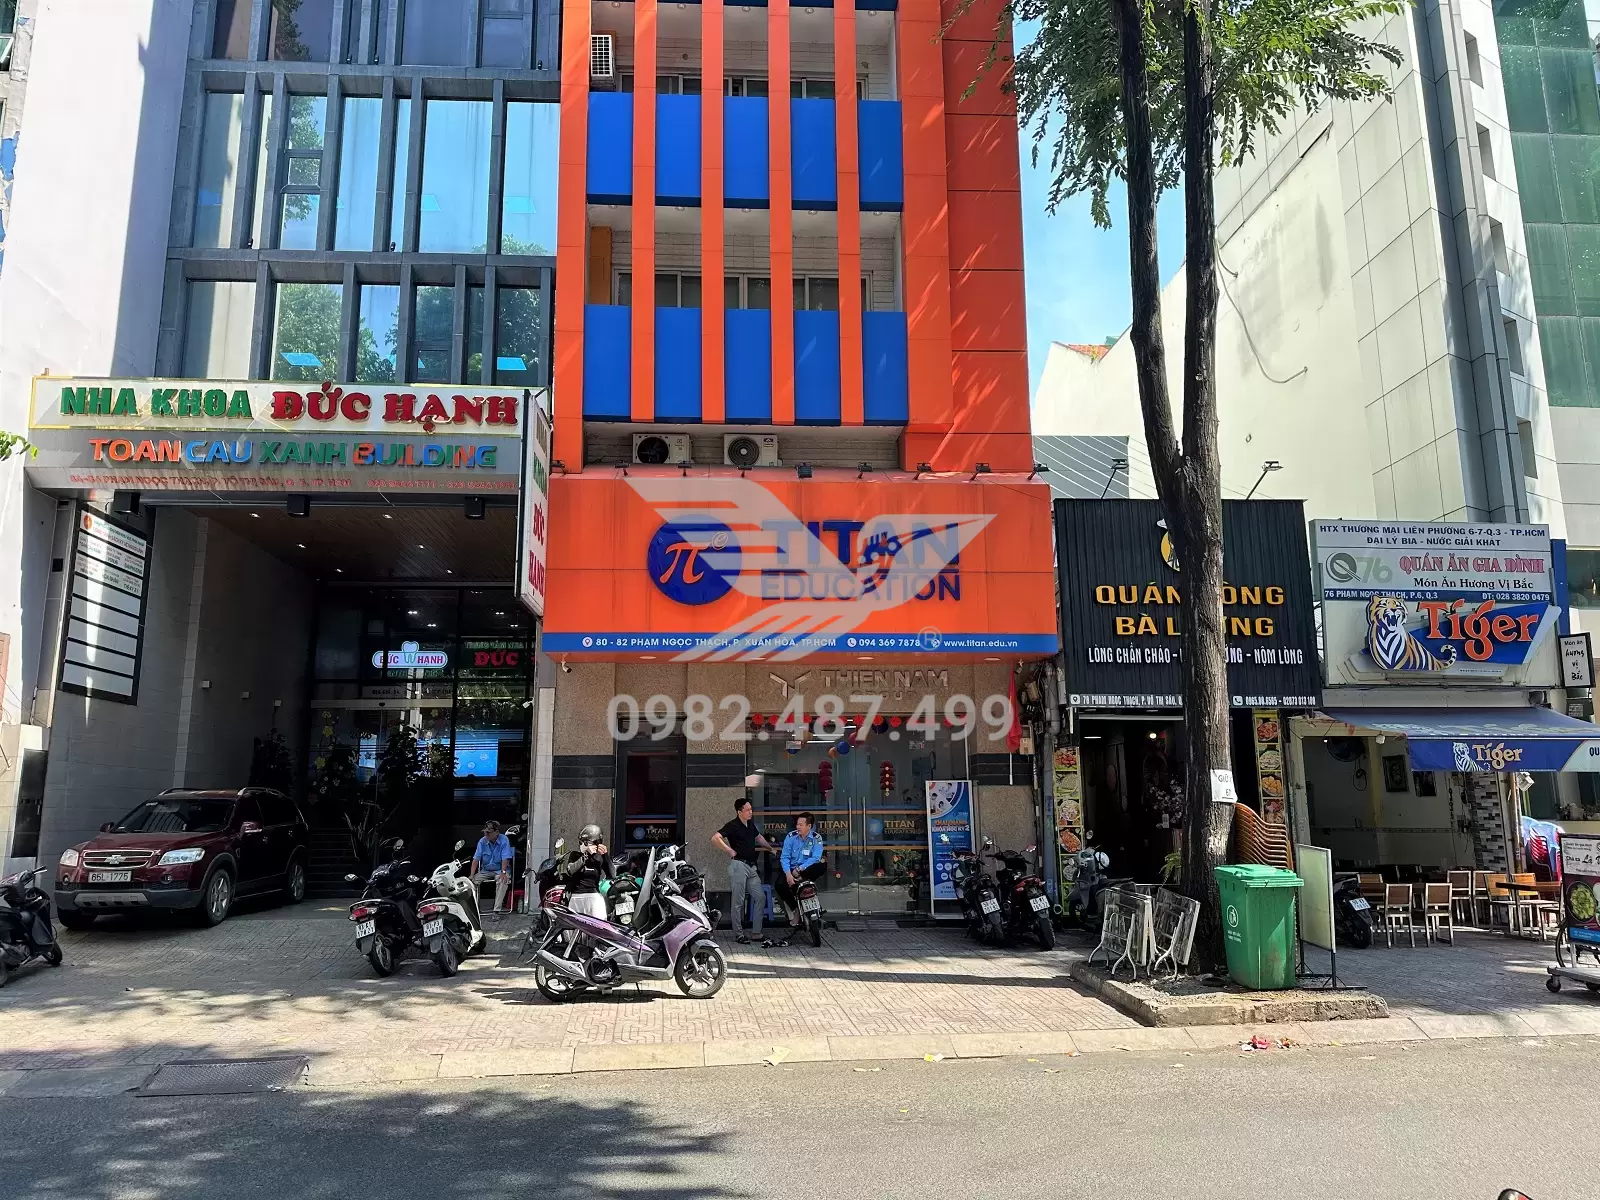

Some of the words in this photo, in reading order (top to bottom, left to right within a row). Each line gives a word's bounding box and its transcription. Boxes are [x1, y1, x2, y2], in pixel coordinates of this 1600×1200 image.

[60, 387, 139, 416] NHA
[151, 388, 254, 419] KHOA
[270, 381, 372, 421] ĐỨC
[382, 393, 520, 434] HẠNH
[89, 438, 181, 463] TOAN
[185, 440, 255, 464] CAU
[259, 441, 347, 465] XANH
[353, 443, 497, 467] BUILDING
[1320, 525, 1339, 533] HTX
[1341, 525, 1383, 534] THƯƠNG
[1385, 526, 1400, 535] MẠI
[1404, 525, 1424, 535] LIÊN
[1468, 528, 1501, 537] 6-7-Q.3
[1511, 529, 1545, 537] TP.HCM
[761, 519, 960, 565] TITAN
[1366, 536, 1384, 545] ĐẠI
[1386, 535, 1398, 545] LÝ
[1401, 537, 1418, 545] BIA
[1426, 536, 1452, 546] NƯỚC
[1454, 537, 1473, 546] GIẢI
[1475, 536, 1501, 547] KHÁT
[1399, 552, 1444, 574] QUÁN
[1446, 552, 1469, 573] ĂN
[1472, 557, 1501, 574] GIA
[1503, 554, 1545, 574] ĐÌNH
[761, 573, 961, 602] EDUCATION
[1413, 577, 1438, 588] Món
[1441, 575, 1457, 588] Ăn
[1459, 579, 1495, 591] Hương
[1498, 579, 1510, 591] Vị
[1513, 576, 1534, 589] Bắc
[1222, 581, 1285, 605] ÒNG
[1325, 590, 1335, 598] 76
[1336, 590, 1358, 599] PHẠM
[1426, 591, 1438, 600] Q.3
[1496, 592, 1510, 600] 028
[1511, 592, 1530, 601] 3820
[1531, 592, 1550, 601] 0479
[1115, 612, 1158, 635] BÀ
[1166, 617, 1274, 636] LNG
[1416, 598, 1540, 662] Tiger
[595, 638, 608, 647] 80
[616, 638, 628, 647] 82
[630, 638, 659, 648] PHẠM
[662, 638, 692, 649] NGỌC
[695, 638, 731, 649] THẠCH,
[733, 638, 741, 647] P.
[801, 638, 836, 648] TP.HCM
[858, 638, 876, 647] 094
[878, 638, 896, 647] 369
[898, 638, 921, 647] 7878
[943, 638, 1018, 648] www.titan.edu.vn
[417, 655, 443, 666] HẠNH
[1088, 645, 1113, 663] LÒNG
[1144, 645, 1171, 664] CHÁO
[1254, 645, 1276, 667] NỘM
[1278, 645, 1303, 665] LÒNG
[893, 669, 949, 689] NAM
[1472, 742, 1523, 770] Tiger
[817, 820, 849, 829] TITAN
[884, 820, 915, 828] TITAN
